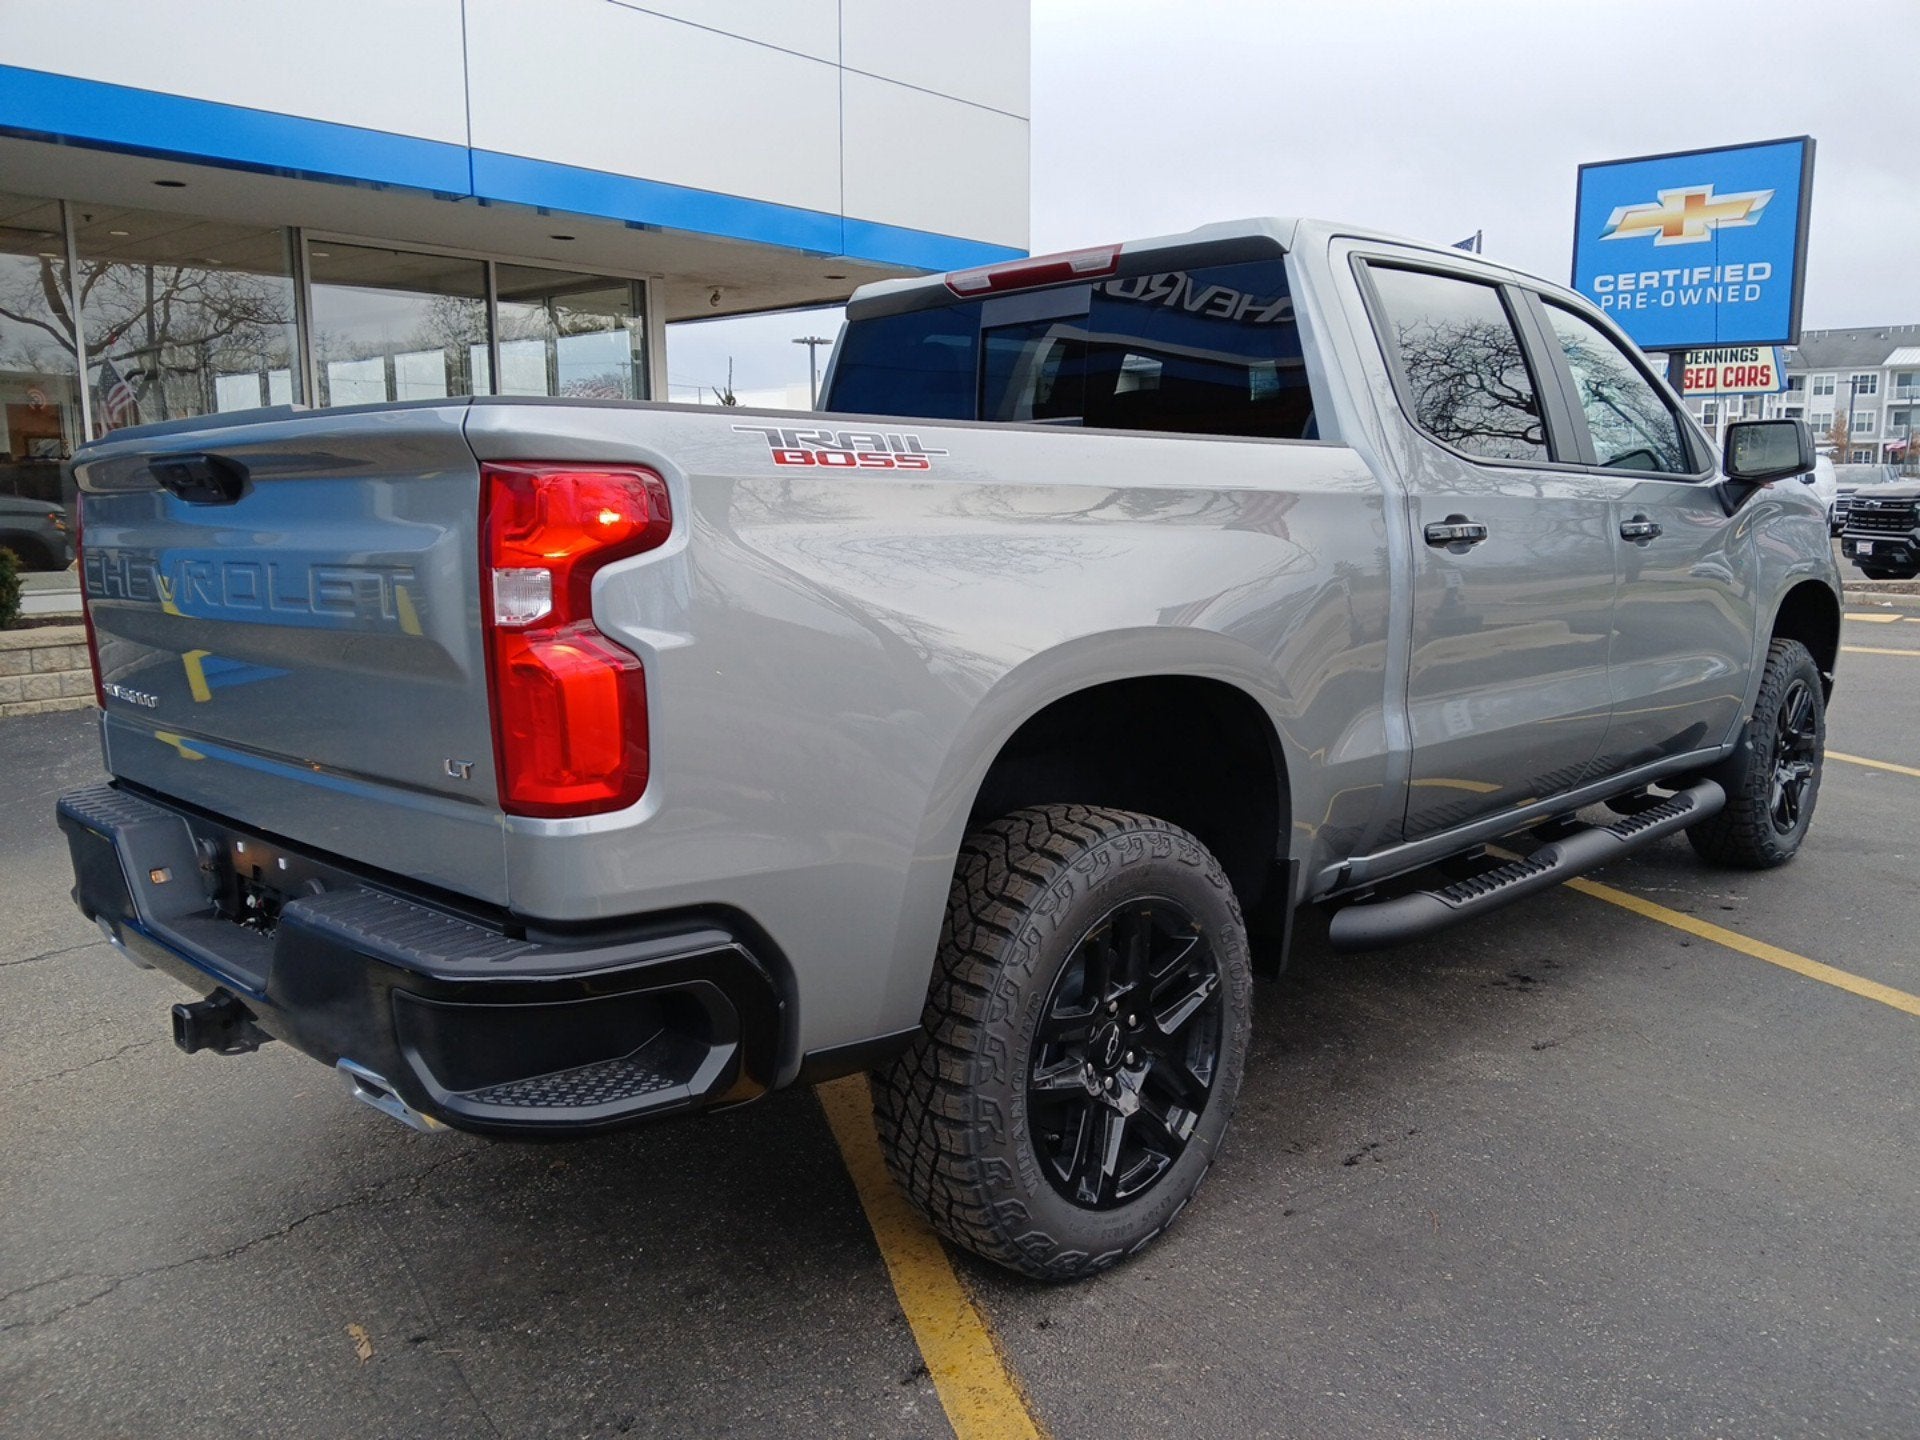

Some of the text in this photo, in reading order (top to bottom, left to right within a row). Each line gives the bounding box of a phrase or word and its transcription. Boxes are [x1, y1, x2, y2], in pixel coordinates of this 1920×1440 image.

[1594, 262, 1772, 293] CERTIFIED
[1600, 284, 1761, 311] PRE-OWNED
[1685, 347, 1759, 365] JENNINGS
[1684, 365, 1772, 389] SED CARS
[731, 424, 949, 456] TRAIL
[770, 447, 931, 471] BOSS
[86, 556, 416, 621] CHEVROLET
[443, 758, 475, 780] LT
